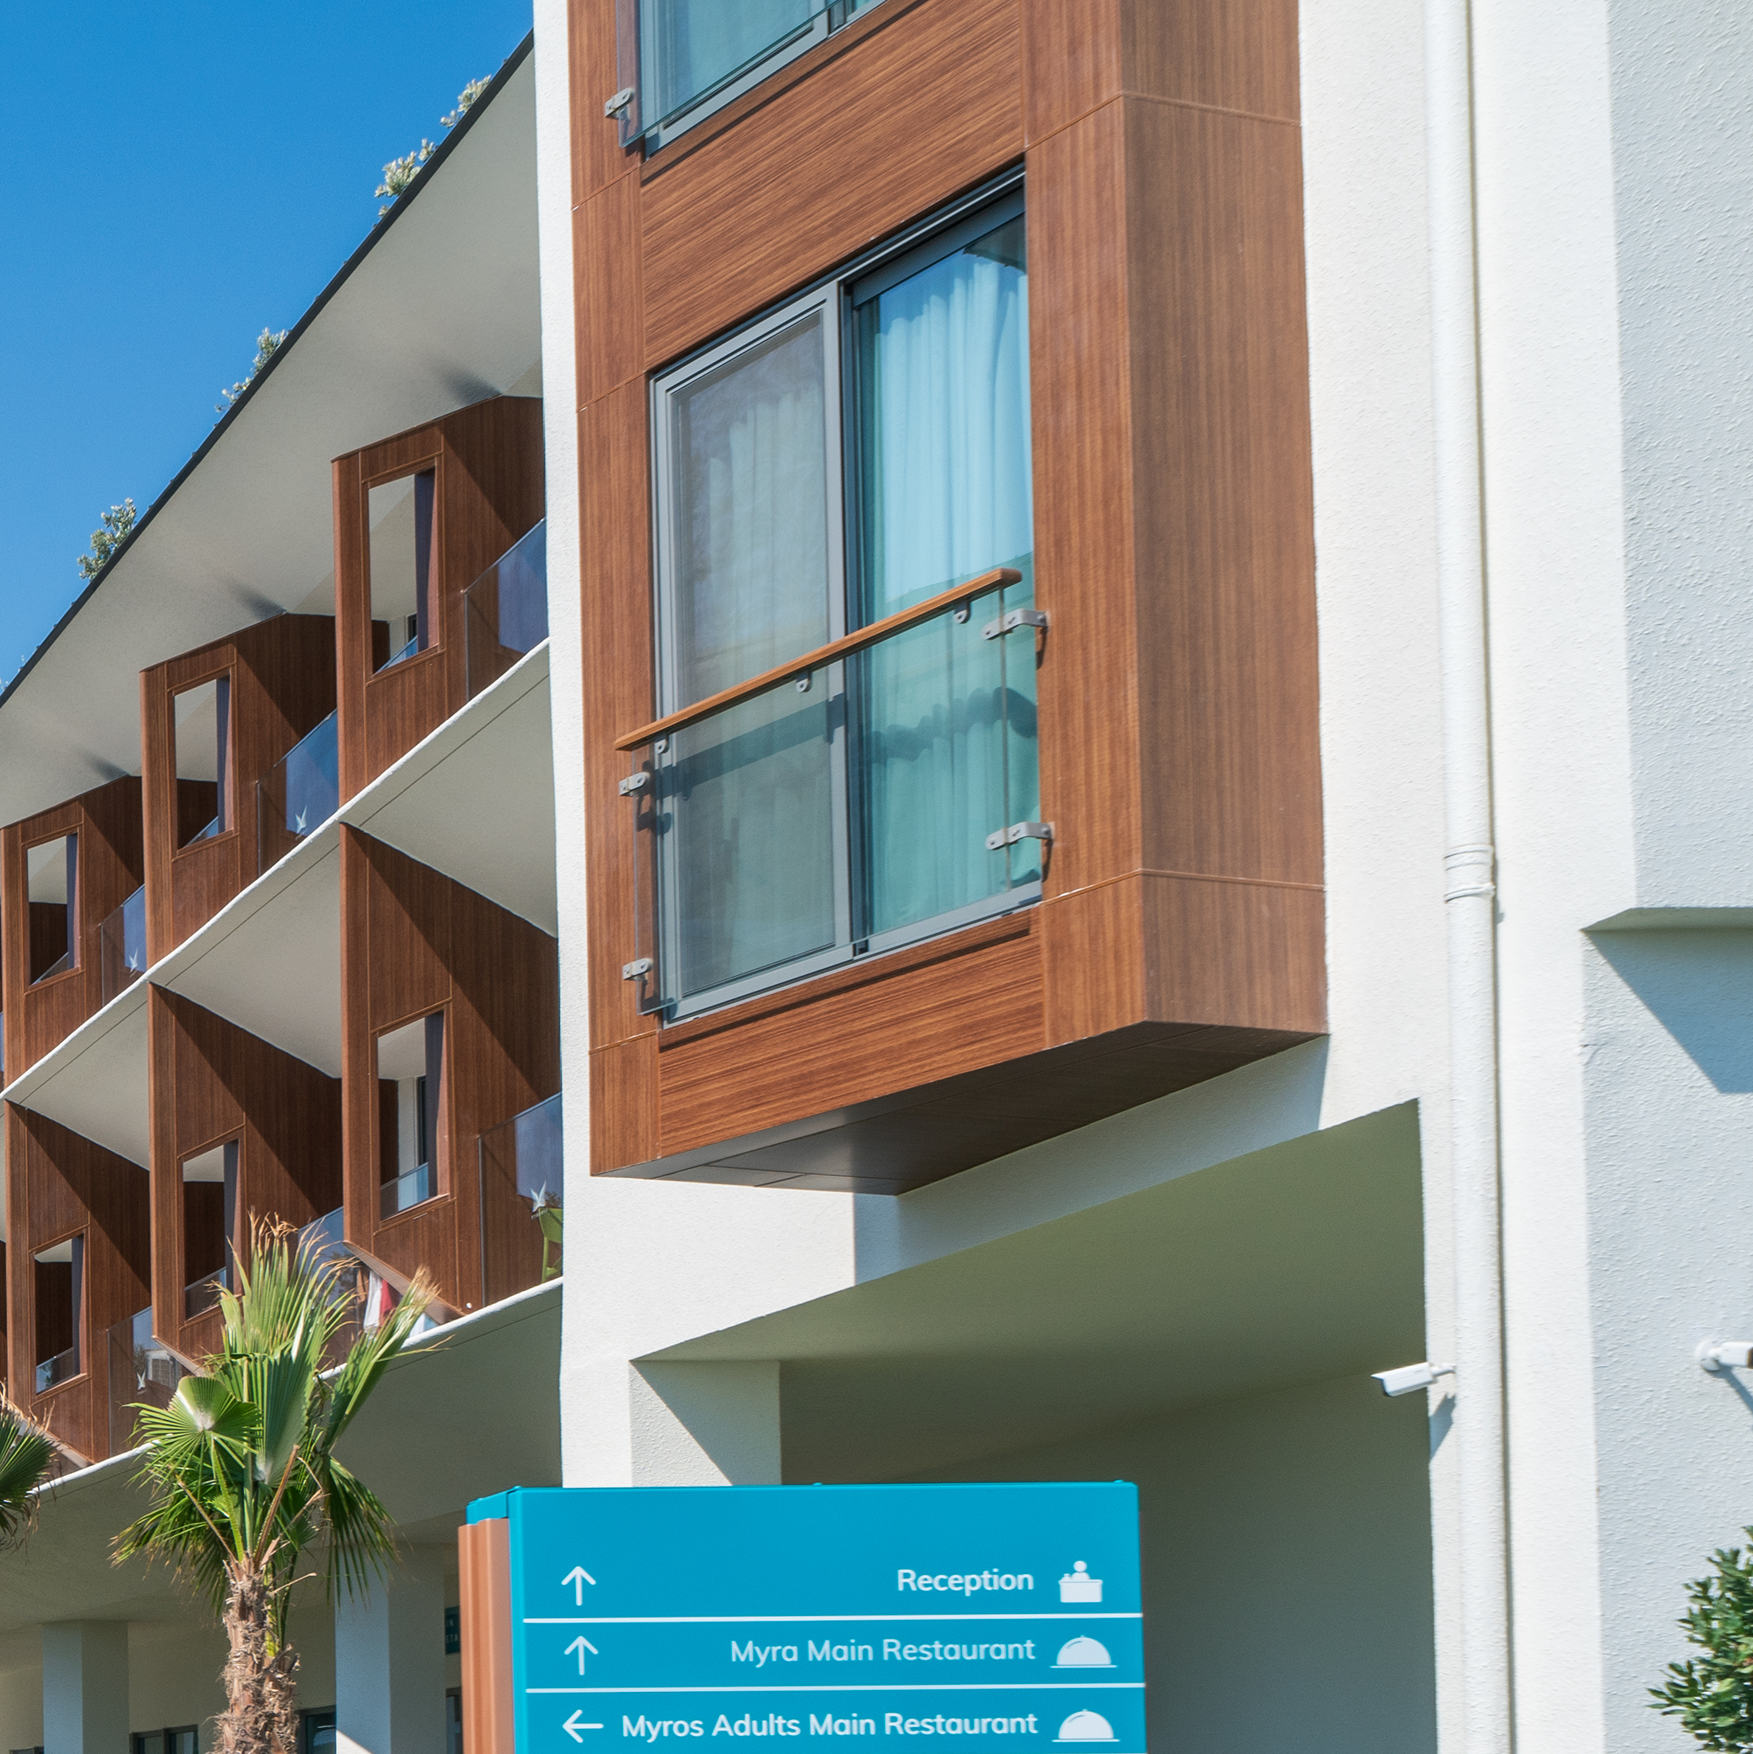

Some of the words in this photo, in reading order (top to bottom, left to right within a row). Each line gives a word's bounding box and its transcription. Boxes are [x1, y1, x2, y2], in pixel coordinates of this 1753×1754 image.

[897, 1567, 1034, 1597] Reception
[731, 1640, 799, 1669] Myra
[807, 1638, 874, 1662] Main
[882, 1638, 1036, 1661] Restaurant
[622, 1714, 705, 1744] Myros
[711, 1713, 802, 1737] Adults
[809, 1712, 876, 1736] Main
[884, 1712, 1039, 1735] Restaurant
